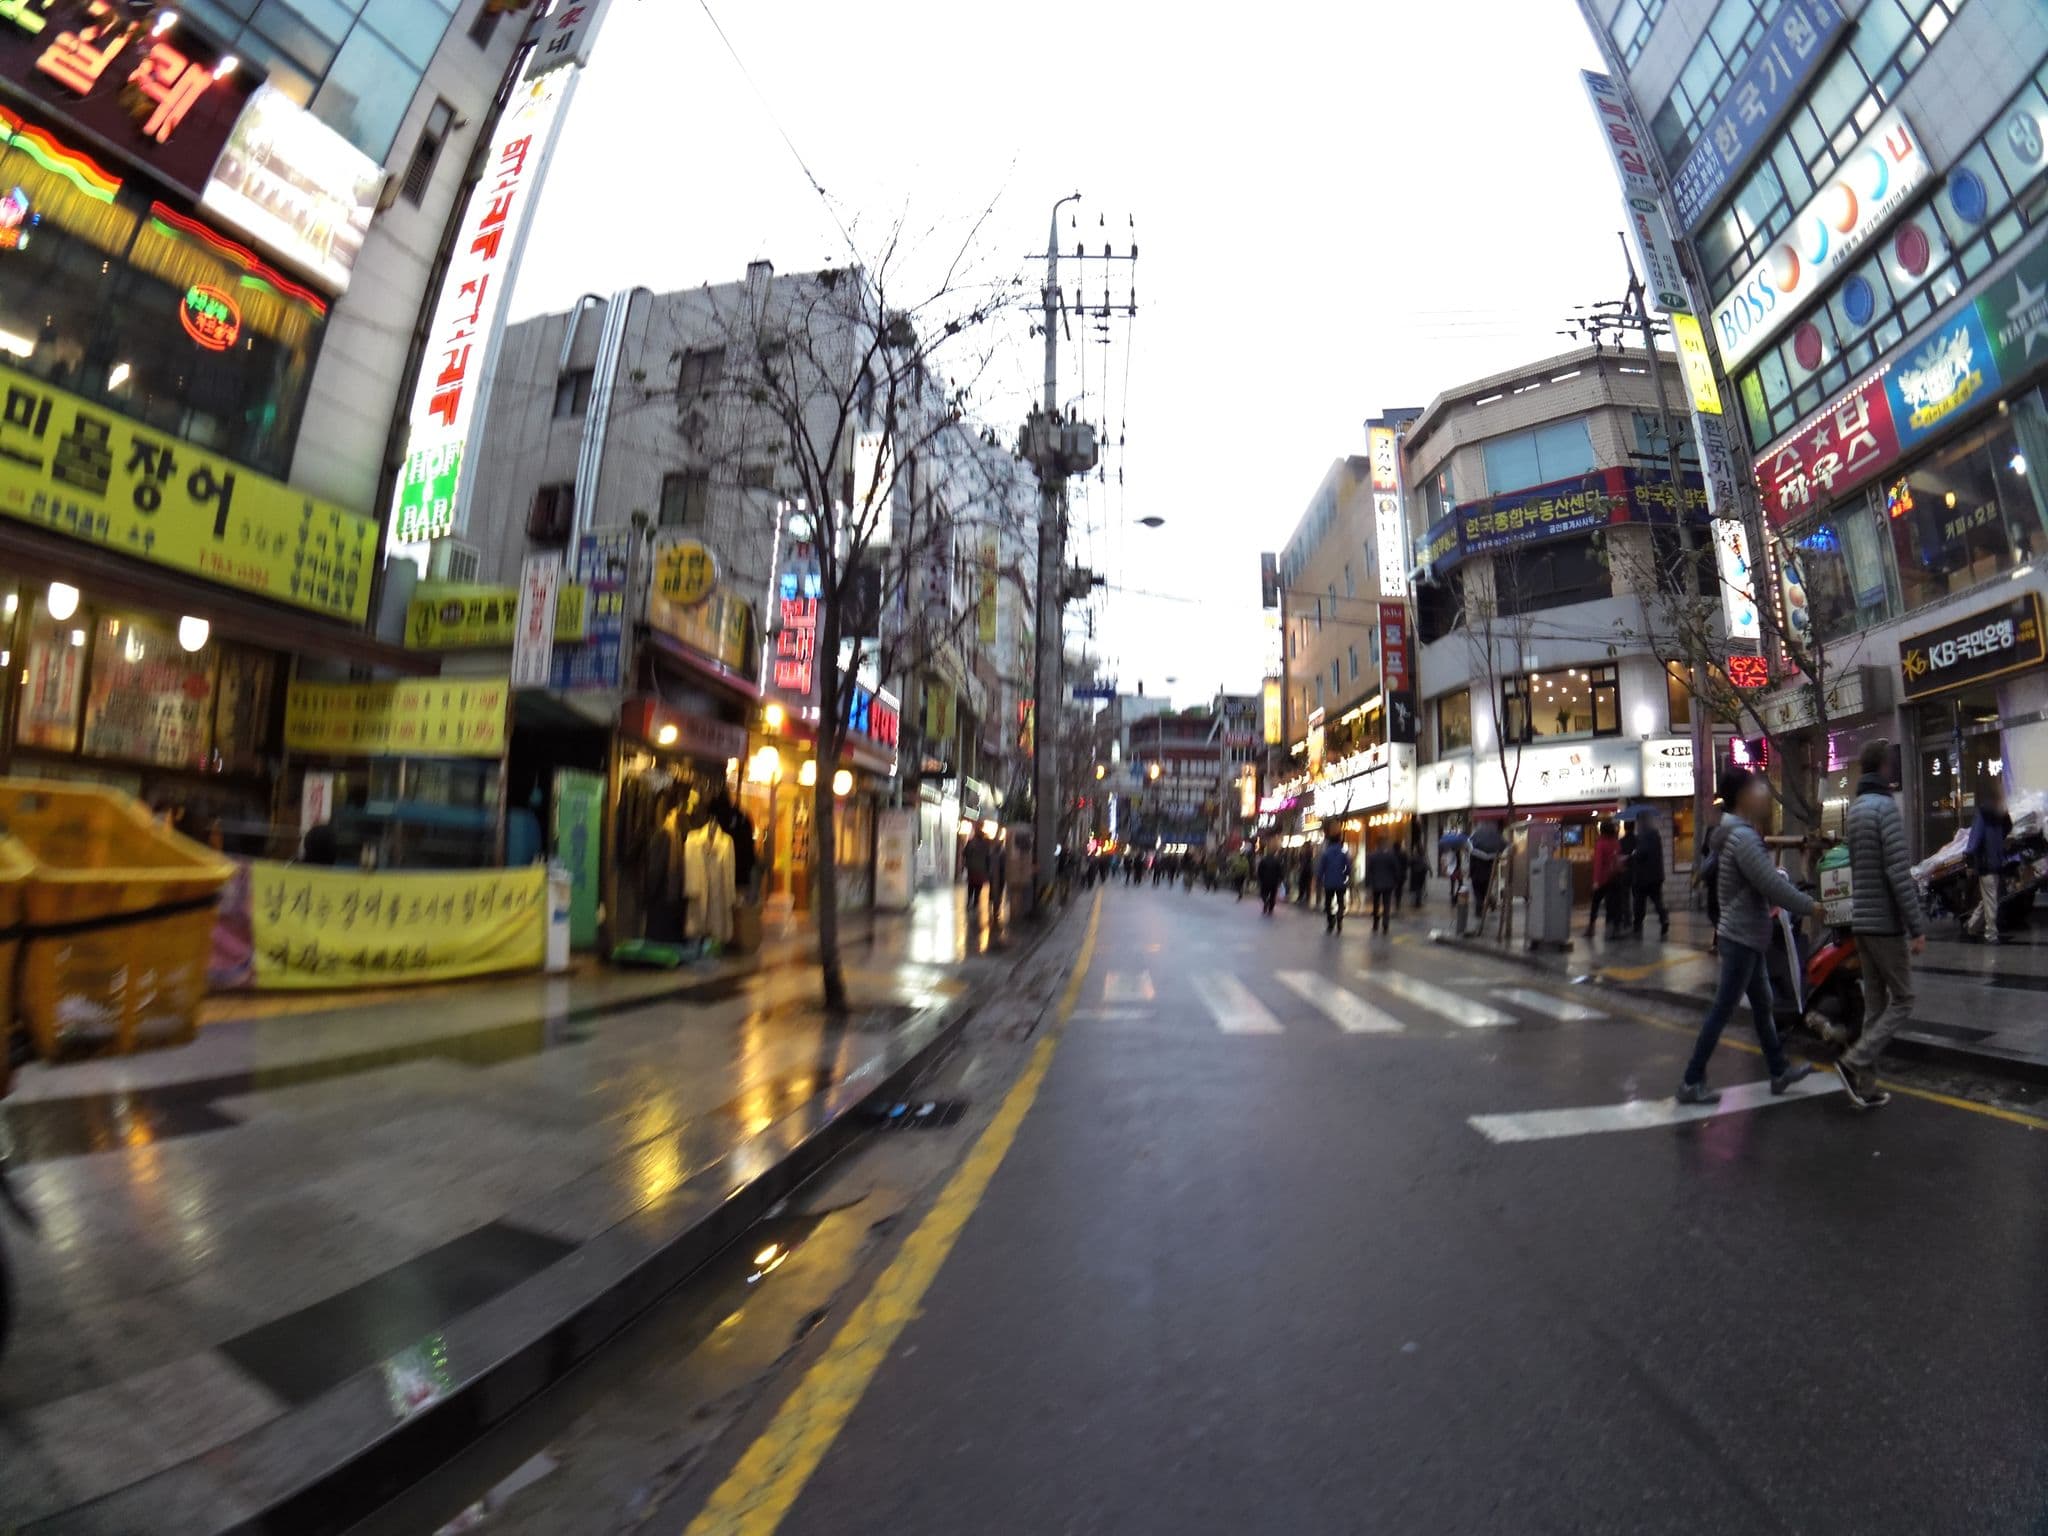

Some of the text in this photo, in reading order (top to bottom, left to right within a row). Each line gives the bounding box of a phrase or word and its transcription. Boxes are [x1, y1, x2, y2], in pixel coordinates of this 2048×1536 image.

[1714, 2, 1818, 166] 한국기원
[1718, 268, 1776, 350] BOSS
[1704, 417, 1733, 499] 한국기원
[1779, 429, 1881, 511] 하우스
[402, 498, 448, 533] BAR
[1928, 618, 2015, 670] KB국민은행
